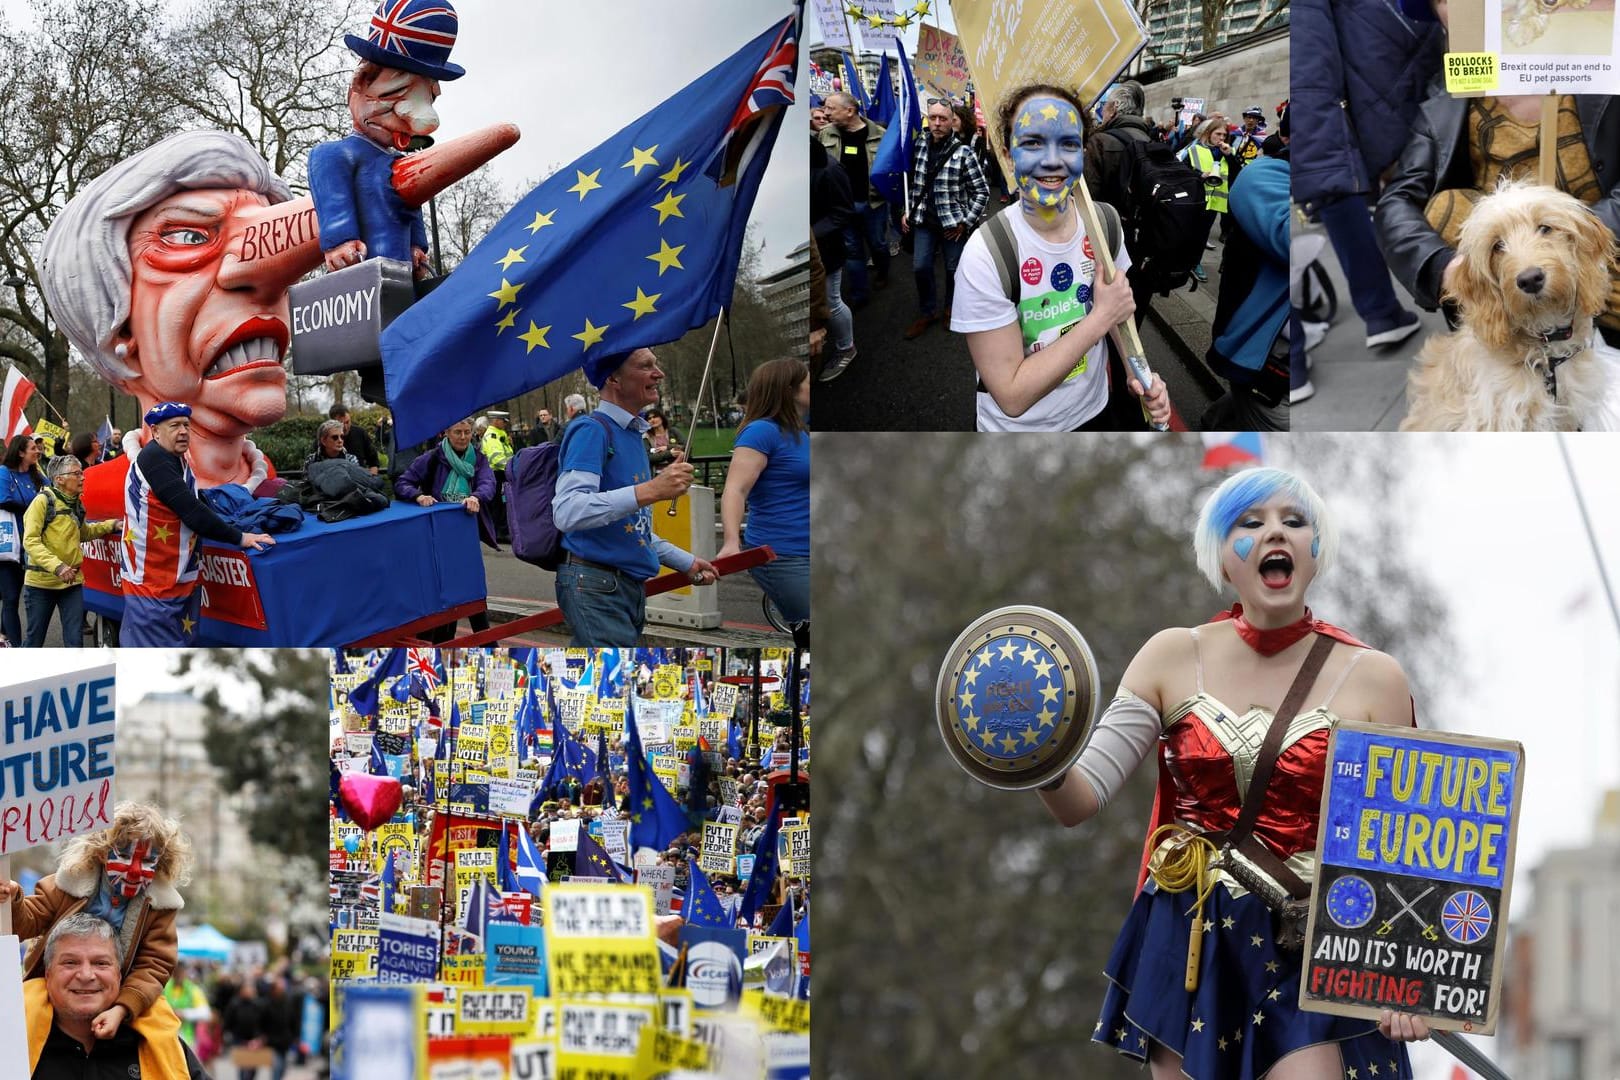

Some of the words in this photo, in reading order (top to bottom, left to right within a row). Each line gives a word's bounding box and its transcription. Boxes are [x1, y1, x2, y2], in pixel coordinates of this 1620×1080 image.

[1449, 56, 1492, 66] BOLLOCKS
[1449, 68, 1460, 76] TO
[1464, 66, 1493, 75] BREXIT
[1501, 62, 1526, 70] Brexit
[1529, 62, 1553, 71] could
[1556, 64, 1569, 73] put
[1585, 62, 1600, 70] end
[1520, 74, 1532, 82] EU
[1535, 75, 1548, 85] pet
[1550, 74, 1592, 85] passports
[238, 208, 317, 263] BREXIT
[294, 286, 376, 335] ECONOMY
[1023, 298, 1080, 324] People's
[111, 567, 122, 587] Le
[5, 676, 115, 744] HAVE
[458, 750, 482, 760] VOTE
[0, 734, 114, 798] TURE
[1337, 761, 1362, 778] THE
[1364, 744, 1512, 816] FUTURE
[706, 826, 722, 835] PUT
[725, 828, 733, 837] IT
[792, 830, 808, 840] PUT
[705, 835, 714, 843] TO
[718, 837, 732, 845] THE
[1335, 826, 1350, 839] IS
[1356, 808, 1503, 877] EUROPE
[704, 843, 732, 853] PEOPLE
[641, 870, 667, 879] WHERE
[555, 898, 587, 914] PUT
[600, 898, 610, 914] IT
[590, 920, 642, 931] PEOPLE
[337, 935, 354, 944] PUT
[357, 935, 366, 944] IT
[370, 935, 379, 944] TO
[752, 940, 769, 949] PUT
[381, 938, 434, 960] TORIES
[498, 946, 534, 955] YOUNG
[584, 953, 655, 969] DEMAND
[1314, 935, 1360, 962] AND
[1364, 939, 1397, 968] IT'S
[1406, 945, 1482, 980] WORTH
[332, 960, 343, 968] WE
[380, 956, 433, 974] AGAINST
[1311, 966, 1424, 1006] FIGHTING
[1434, 984, 1486, 1017] FOR!
[463, 995, 486, 1007] PUT
[493, 995, 503, 1005] IT
[510, 995, 525, 1006] TO
[486, 1009, 523, 1019] PEOPLE
[564, 1011, 594, 1028] PUT
[514, 1050, 548, 1078] UT
